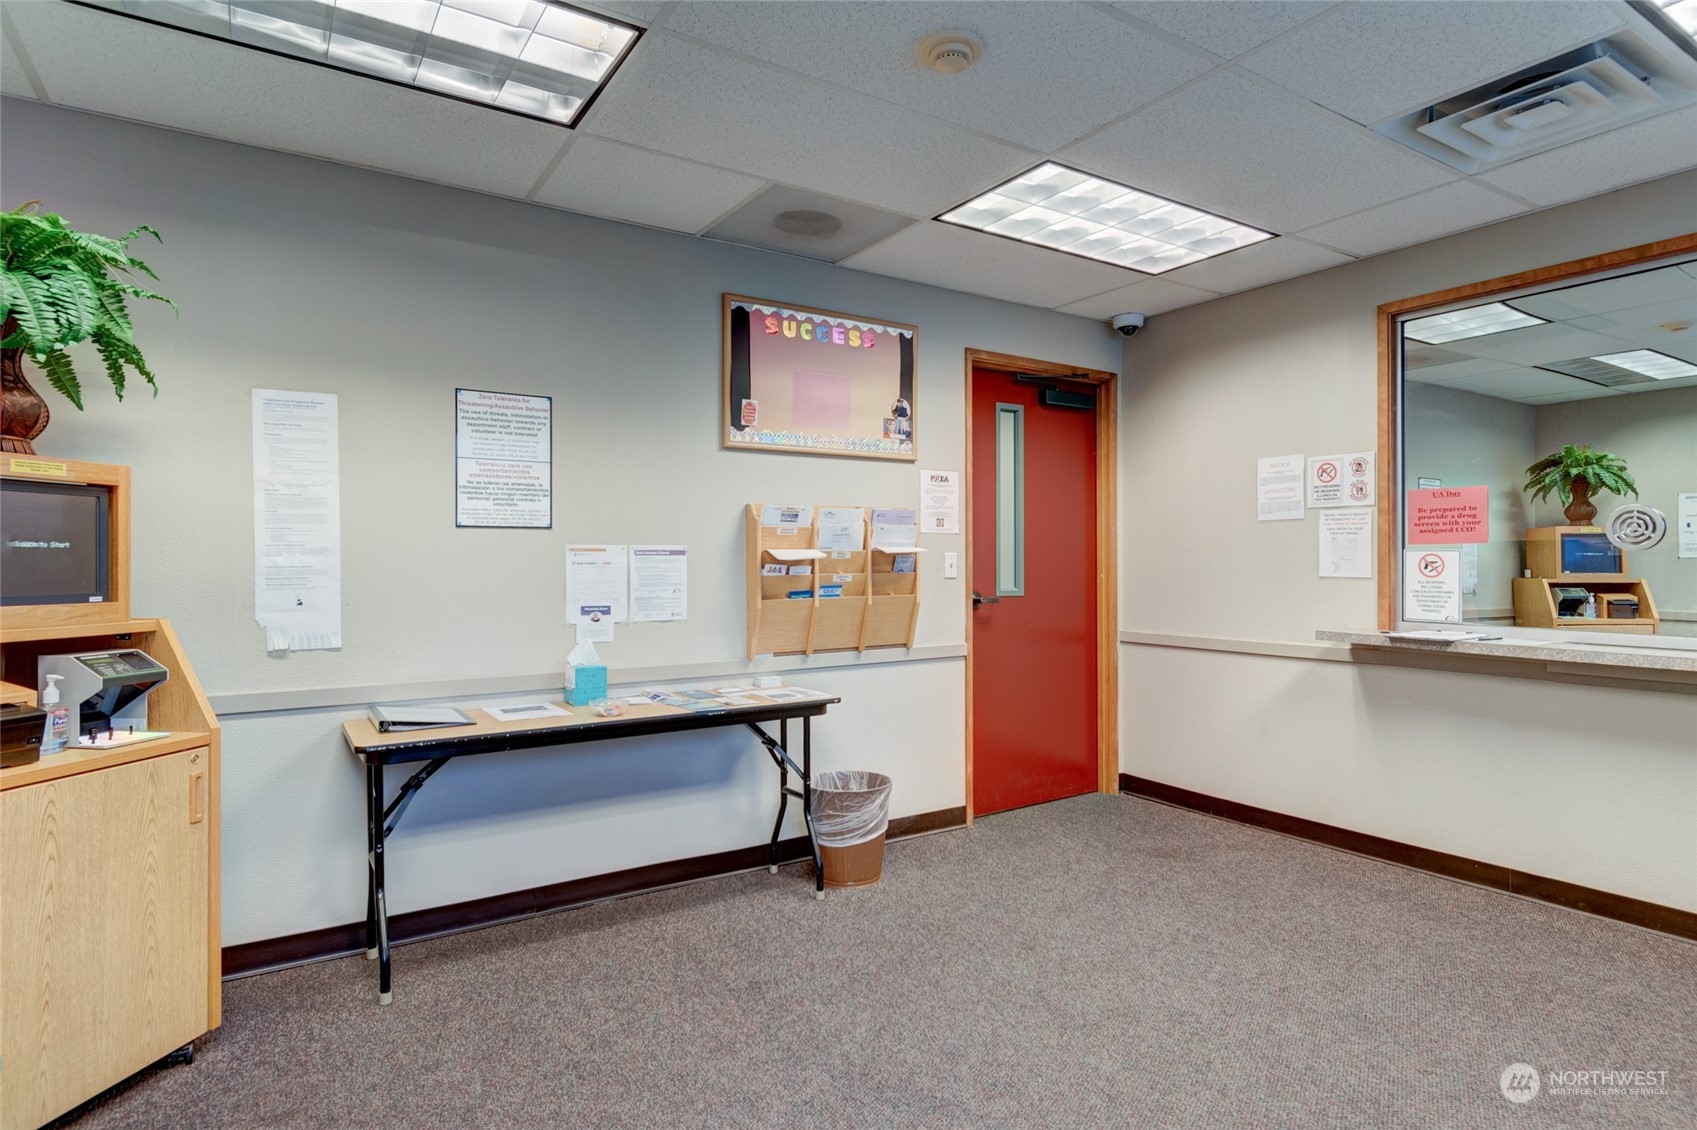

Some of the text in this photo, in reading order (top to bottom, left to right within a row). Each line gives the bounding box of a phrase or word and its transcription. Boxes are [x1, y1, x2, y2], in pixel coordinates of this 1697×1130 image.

[765, 316, 875, 348] SUCCESS
[458, 400, 524, 411] Threatening/Assaultive
[930, 474, 949, 483] PREA
[1430, 505, 1467, 514] prepared
[1418, 513, 1449, 521] provide
